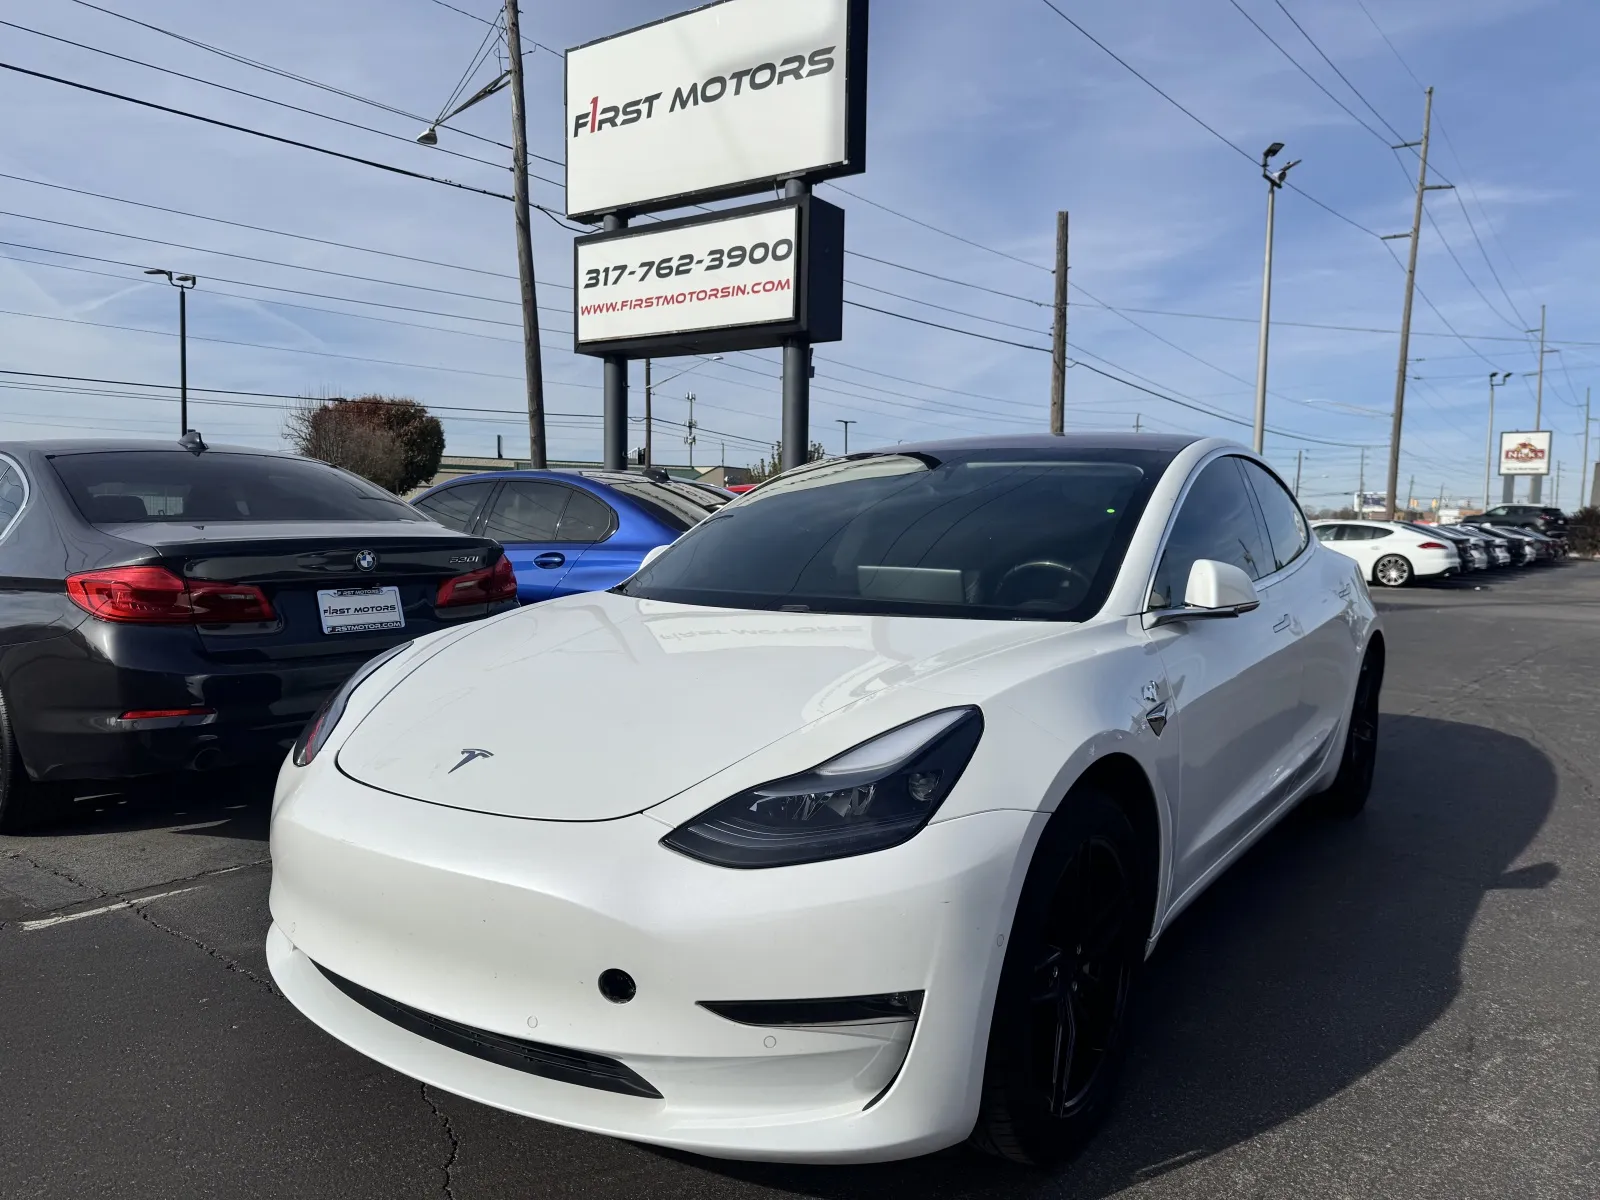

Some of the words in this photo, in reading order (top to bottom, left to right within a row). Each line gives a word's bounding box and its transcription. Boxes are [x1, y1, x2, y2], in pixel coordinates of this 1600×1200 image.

[668, 45, 837, 114] MOTORS
[583, 238, 794, 289] 317-762-3900
[580, 278, 791, 317] WWW.FIRSTMOTORSIN.COM
[327, 621, 401, 633] FRSTMOTOR.COM
[353, 604, 397, 614] MOTORS
